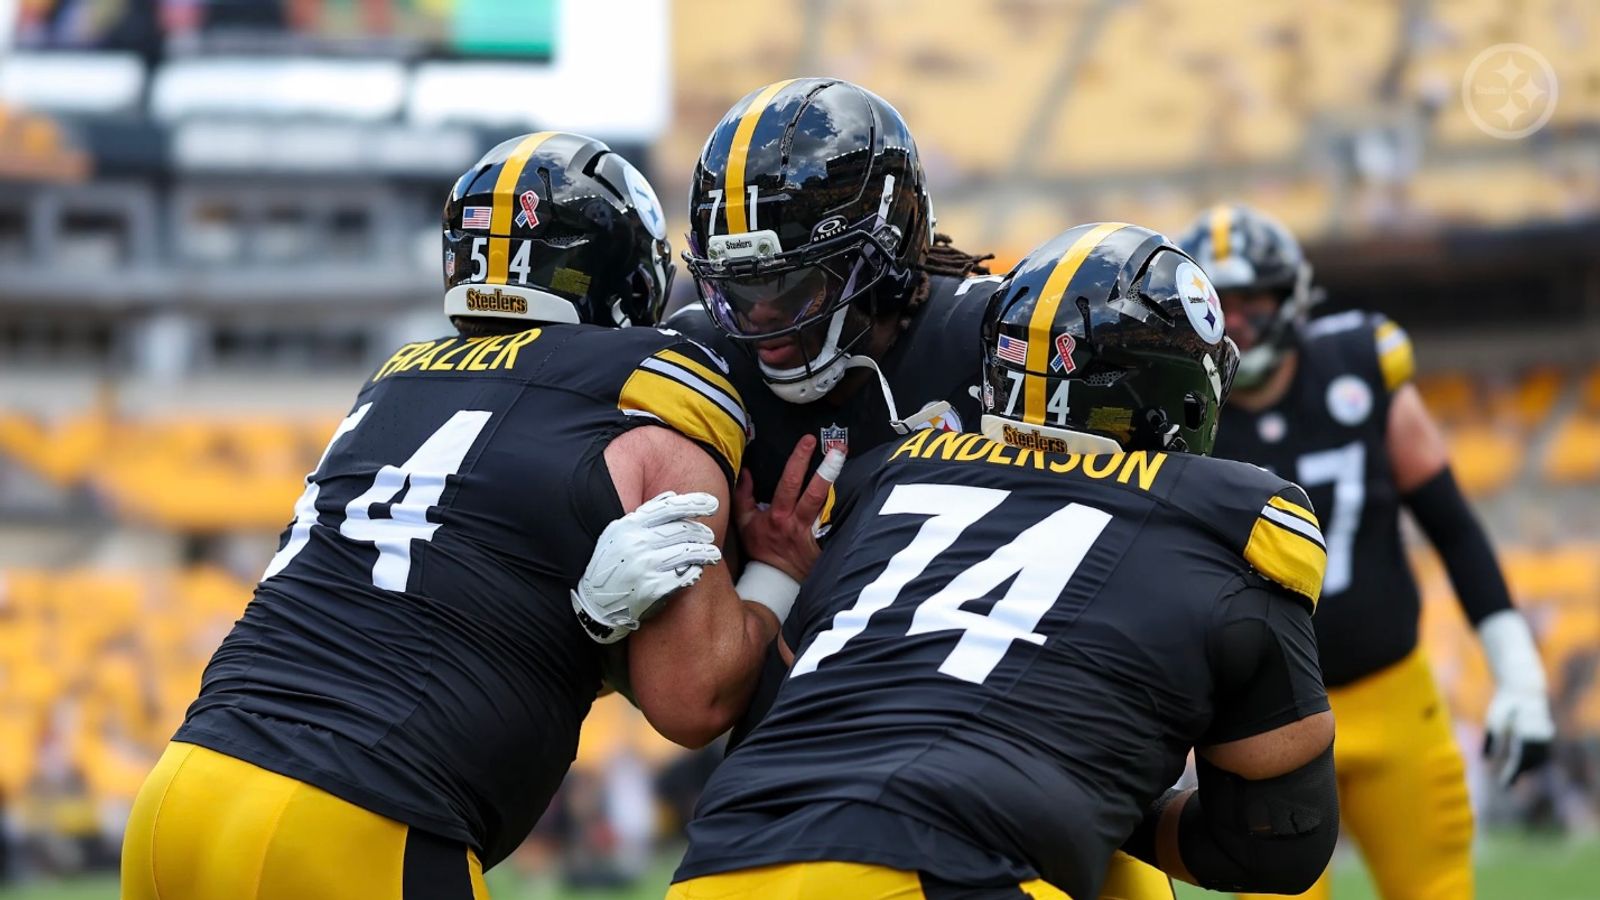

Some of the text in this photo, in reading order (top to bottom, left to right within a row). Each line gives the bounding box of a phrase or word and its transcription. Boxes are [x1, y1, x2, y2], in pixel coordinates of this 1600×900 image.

[725, 239, 753, 250] Steelers
[813, 225, 848, 242] OAKLEY
[466, 287, 528, 315] Steelers
[372, 327, 543, 382] FRAZIER
[1002, 423, 1068, 454] Steelers
[789, 483, 1114, 685] 74
